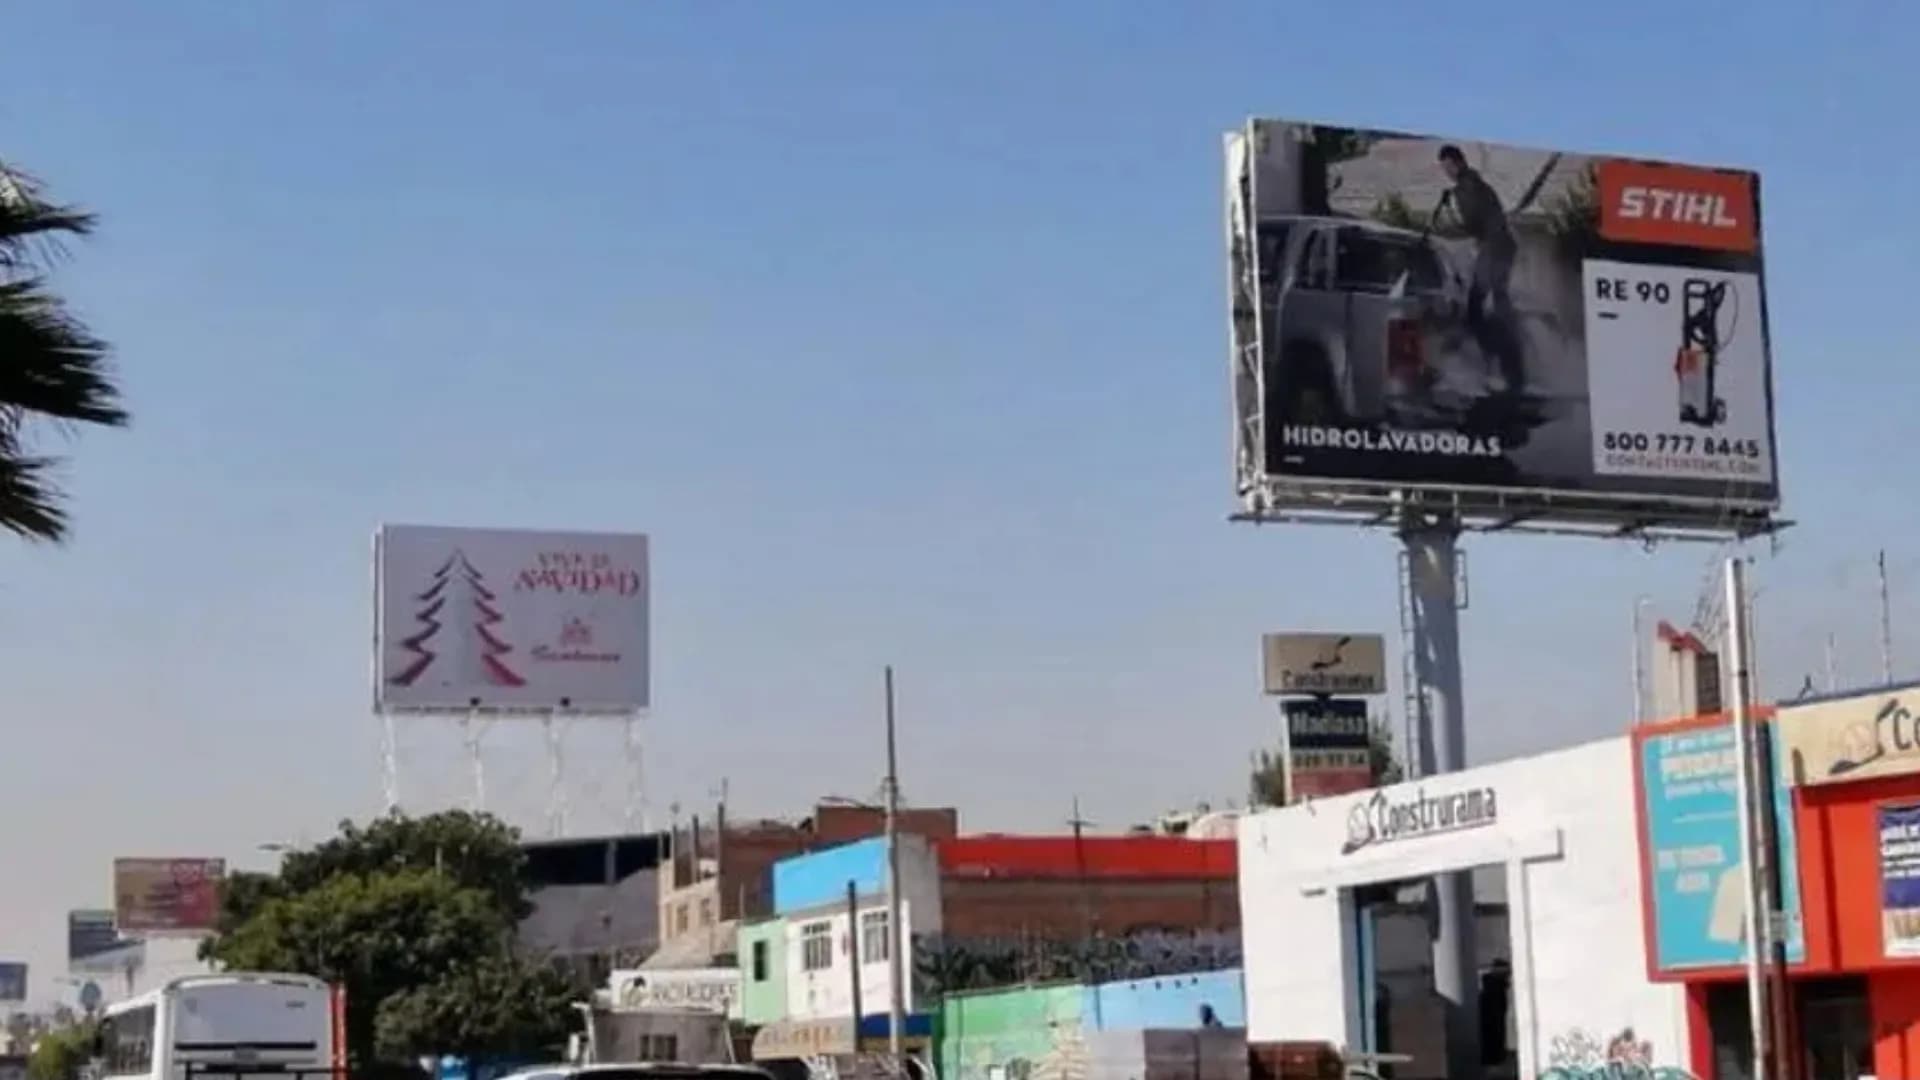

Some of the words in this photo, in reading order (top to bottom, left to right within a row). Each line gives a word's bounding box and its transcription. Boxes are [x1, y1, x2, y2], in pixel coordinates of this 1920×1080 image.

[1618, 186, 1737, 228] STIHL
[1595, 277, 1628, 301] RE
[1636, 280, 1671, 305] 90
[1282, 424, 1502, 458] HIDROLAVADORAS
[1604, 432, 1648, 451] 800
[1656, 433, 1695, 453] 777
[1378, 787, 1498, 839] Construrama
